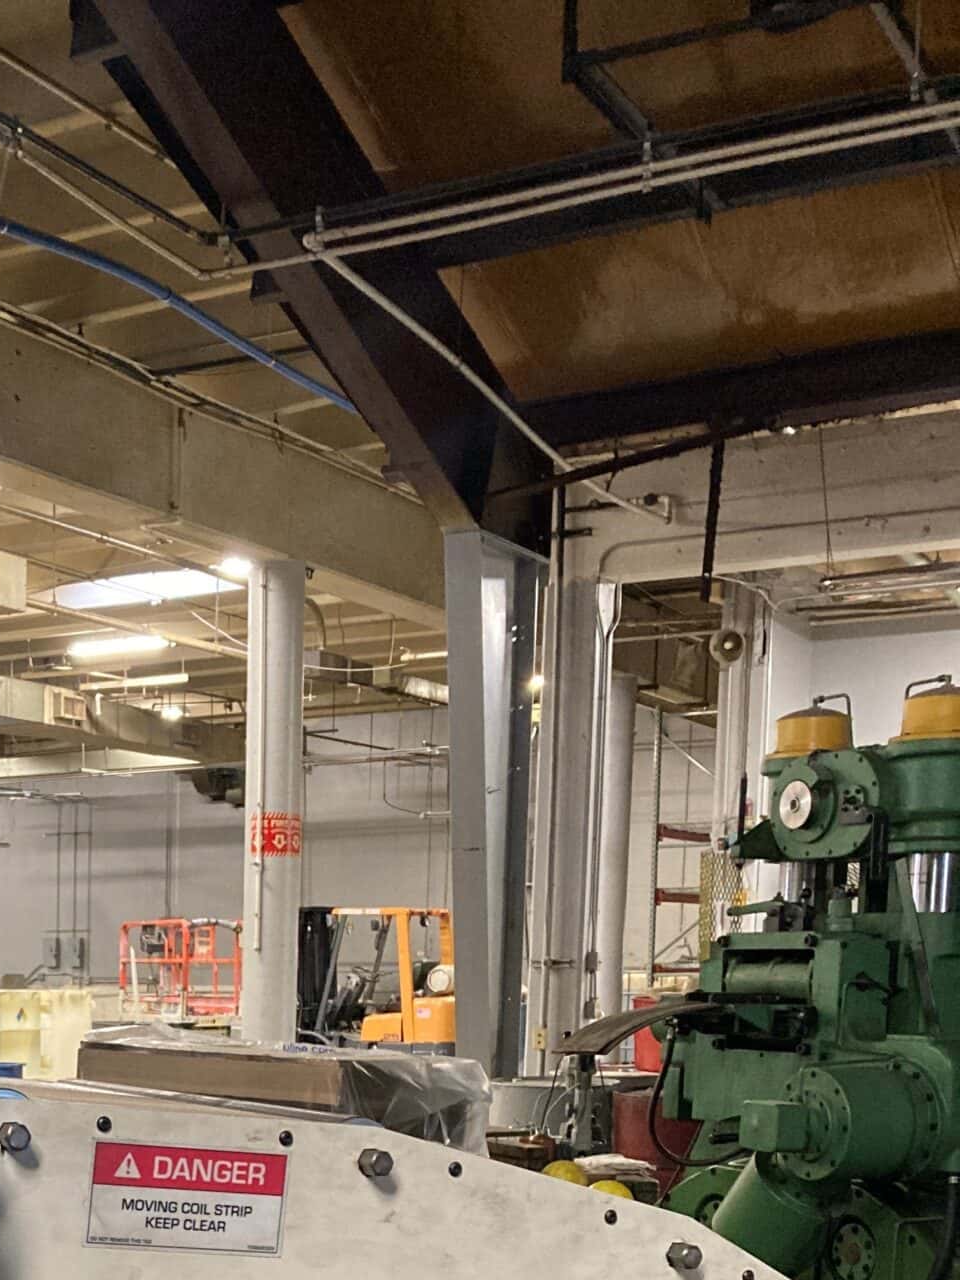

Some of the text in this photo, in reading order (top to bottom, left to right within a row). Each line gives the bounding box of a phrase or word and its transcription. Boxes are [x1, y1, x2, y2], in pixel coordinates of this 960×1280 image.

[152, 1155, 266, 1186] DANGER
[121, 1198, 253, 1218] MOVING COIL STRIP
[145, 1216, 227, 1233] KEEP CLEAR
